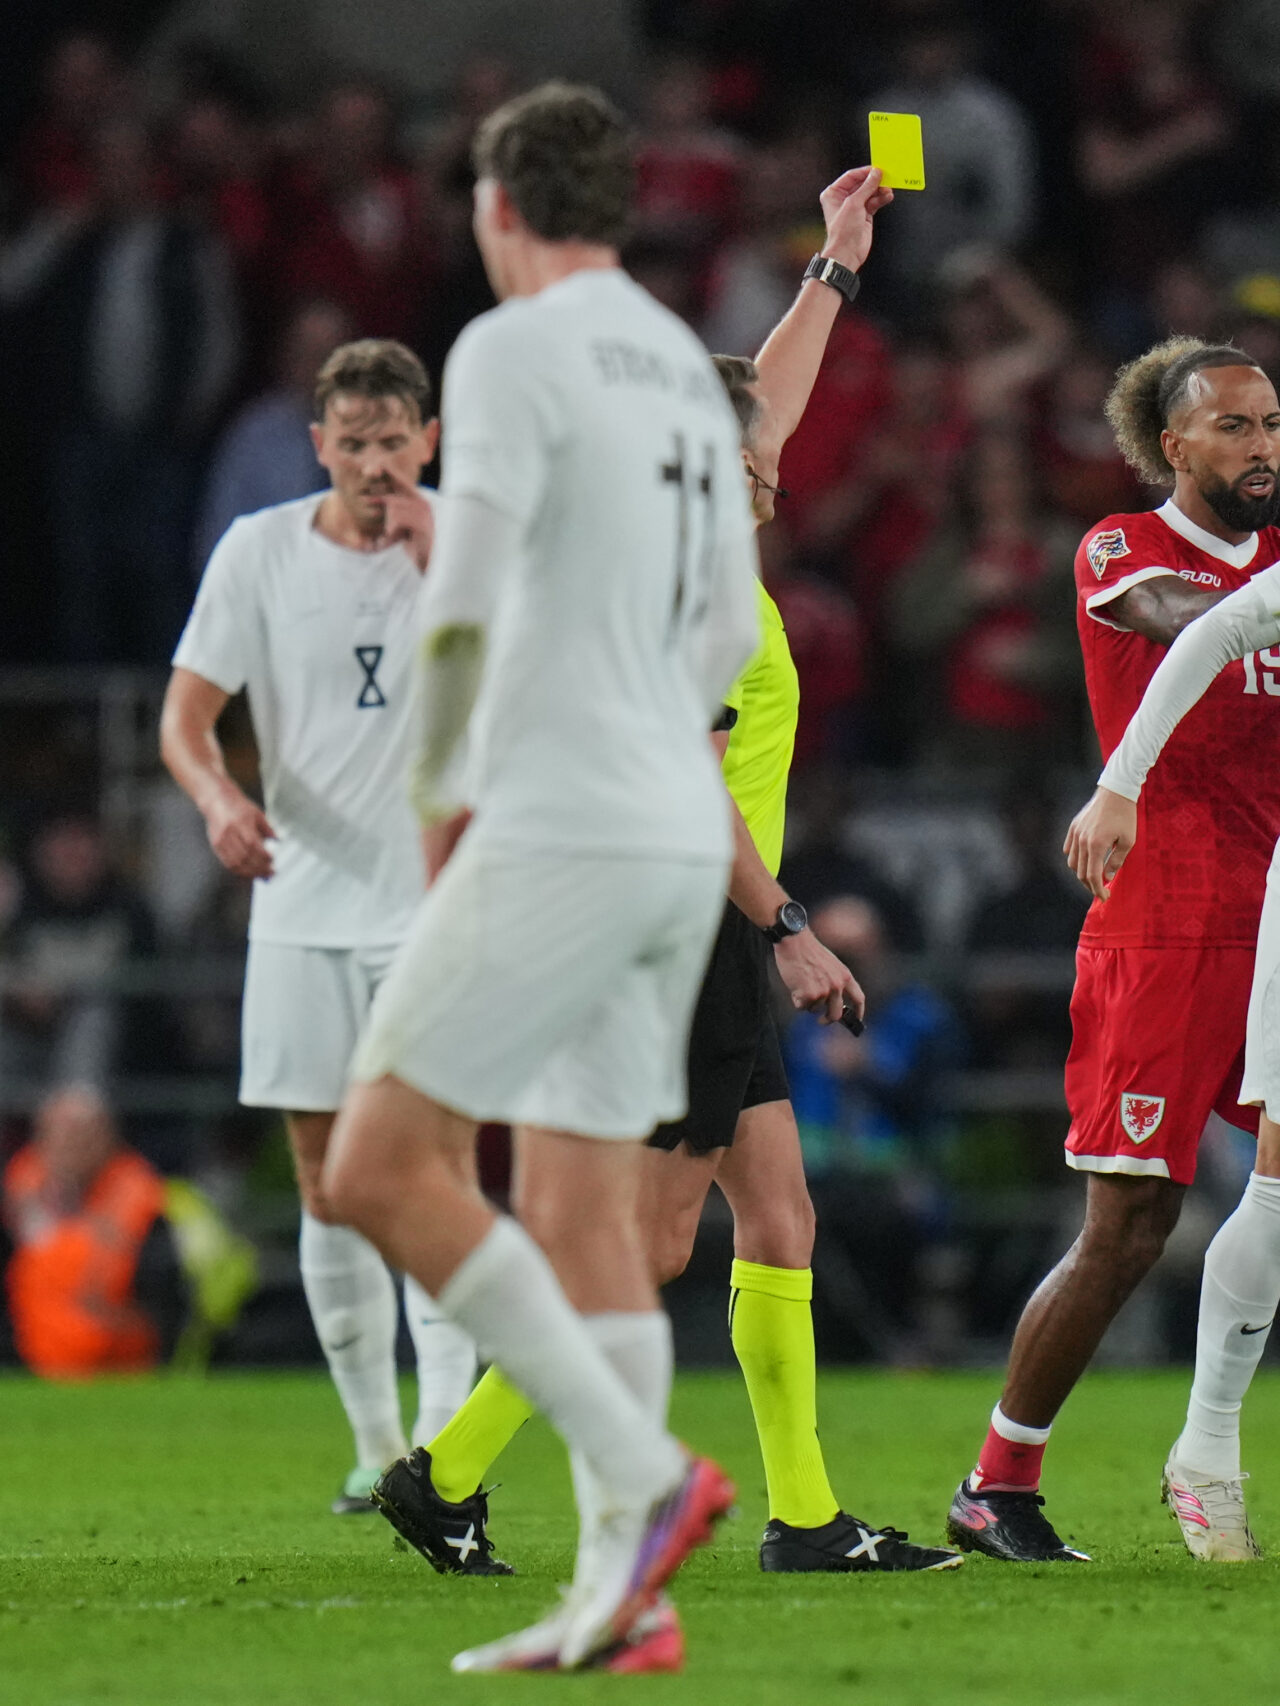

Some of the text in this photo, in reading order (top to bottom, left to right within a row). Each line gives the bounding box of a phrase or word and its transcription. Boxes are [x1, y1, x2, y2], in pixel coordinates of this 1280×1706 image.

[872, 114, 889, 122] UEFA
[1178, 569, 1222, 588] SUDU
[354, 645, 387, 709] 8
